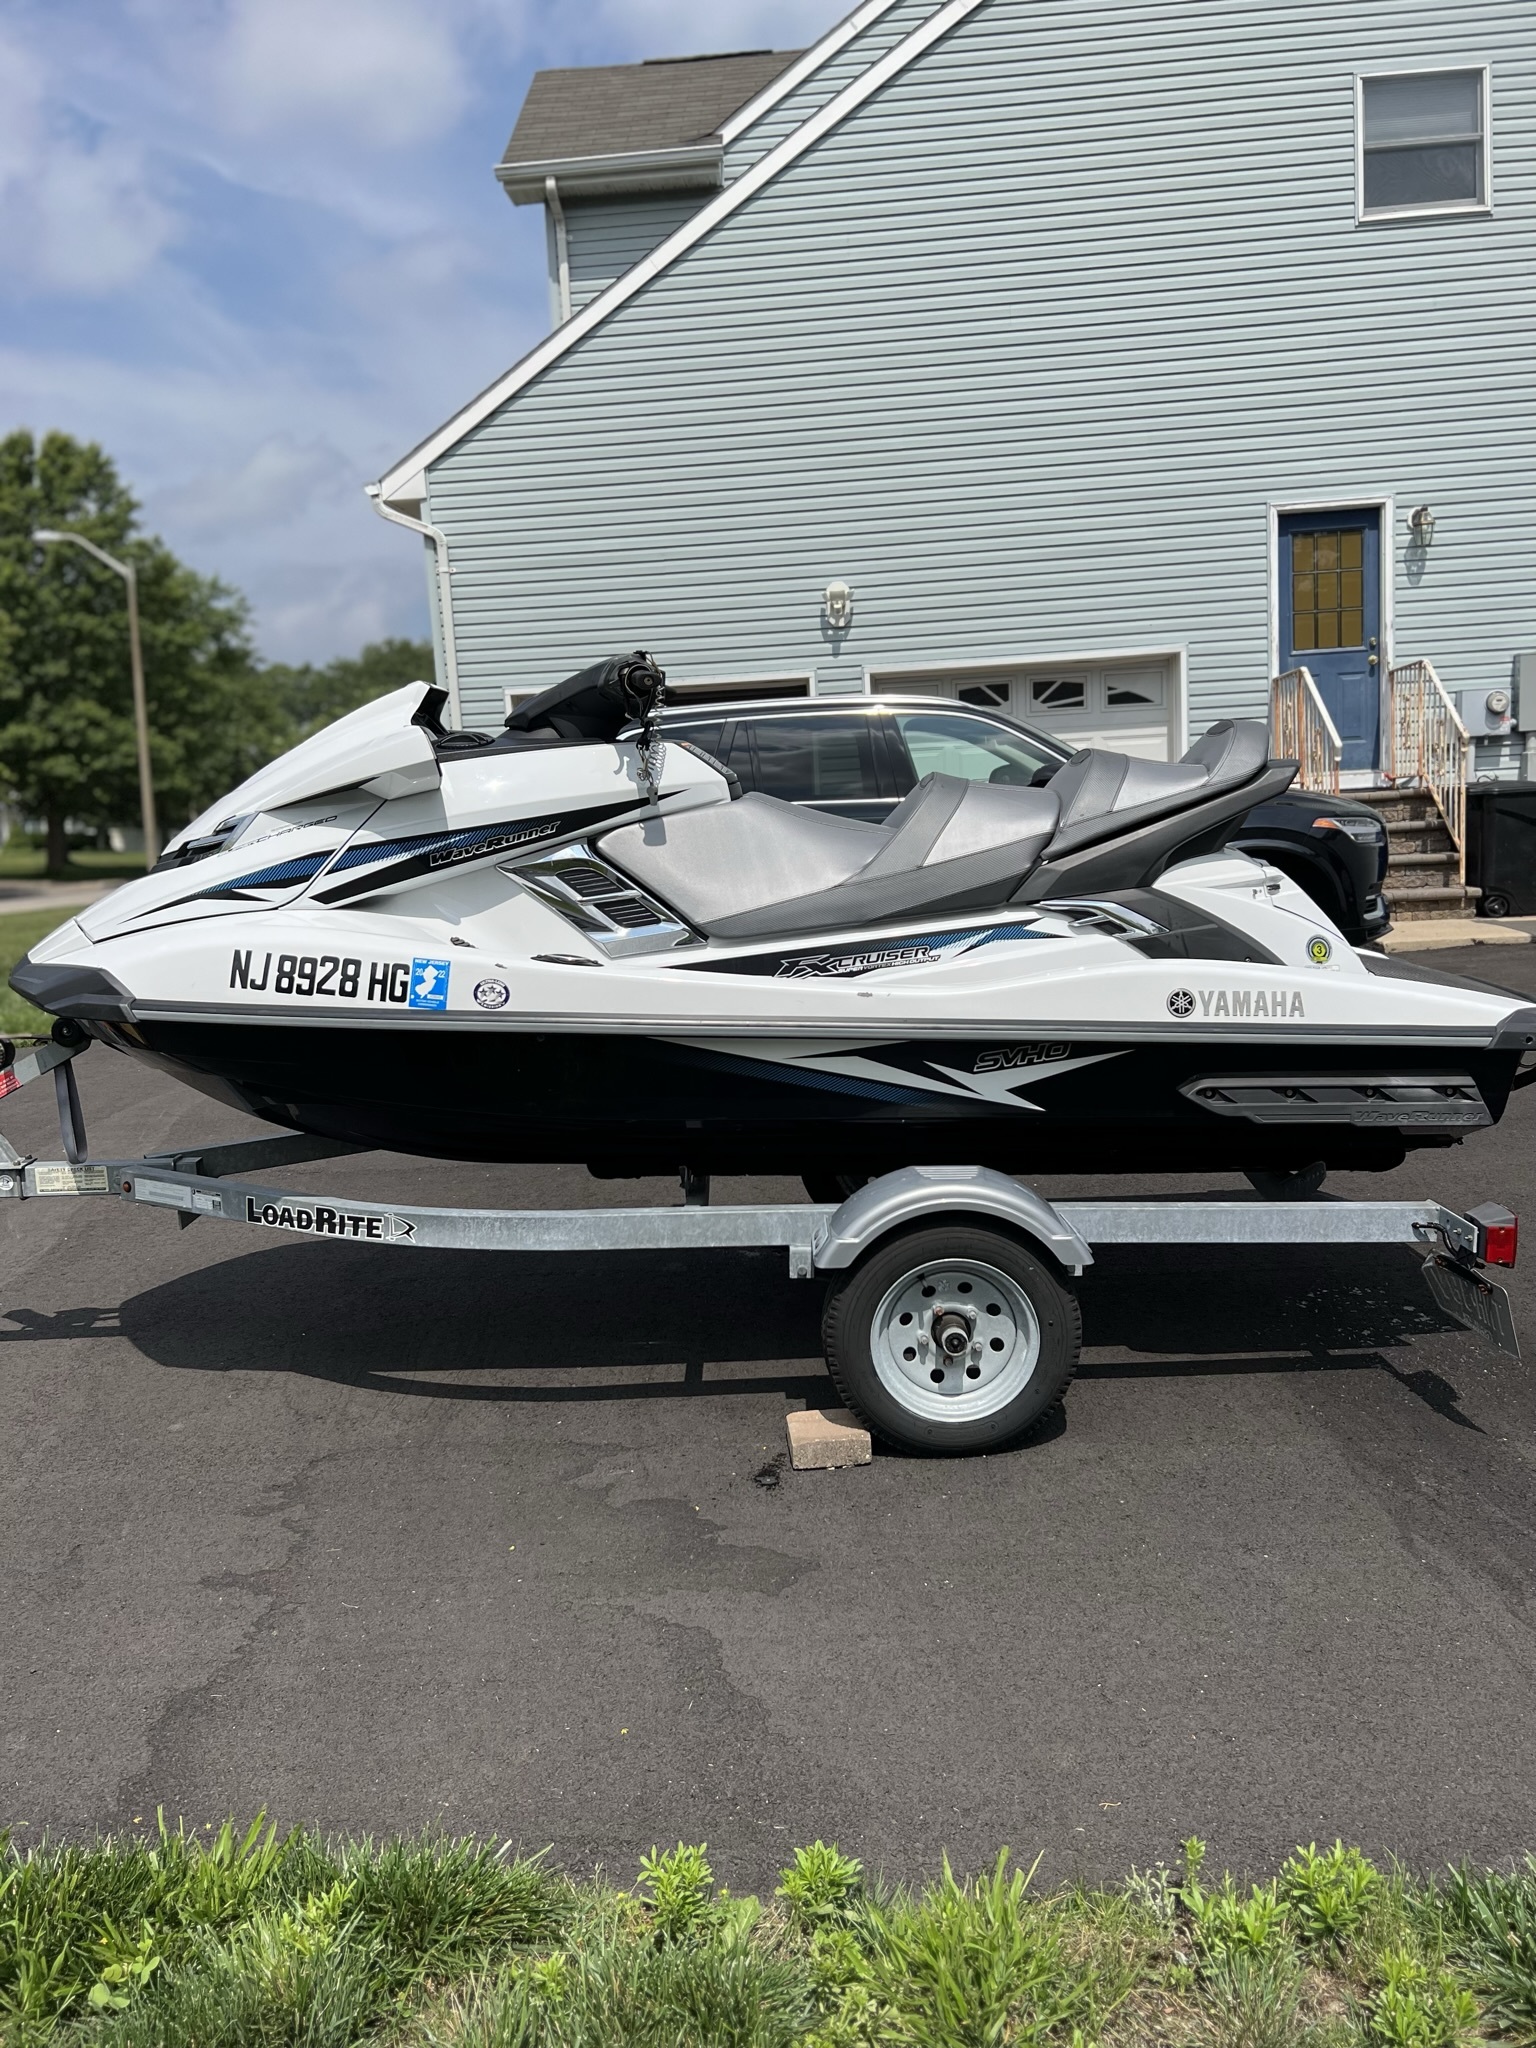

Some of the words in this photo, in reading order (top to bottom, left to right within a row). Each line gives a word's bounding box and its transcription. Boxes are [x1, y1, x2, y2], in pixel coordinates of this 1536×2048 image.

[430, 821, 561, 866] WaveRunner
[229, 949, 272, 991] NJ
[275, 954, 362, 998] 8928
[367, 962, 411, 1003] HG
[773, 954, 839, 979] FX
[837, 946, 930, 969] CRUISER
[1198, 990, 1306, 1017] YAMAHA
[973, 1042, 1072, 1072] SVHO
[1354, 1110, 1484, 1122] WaveRunner
